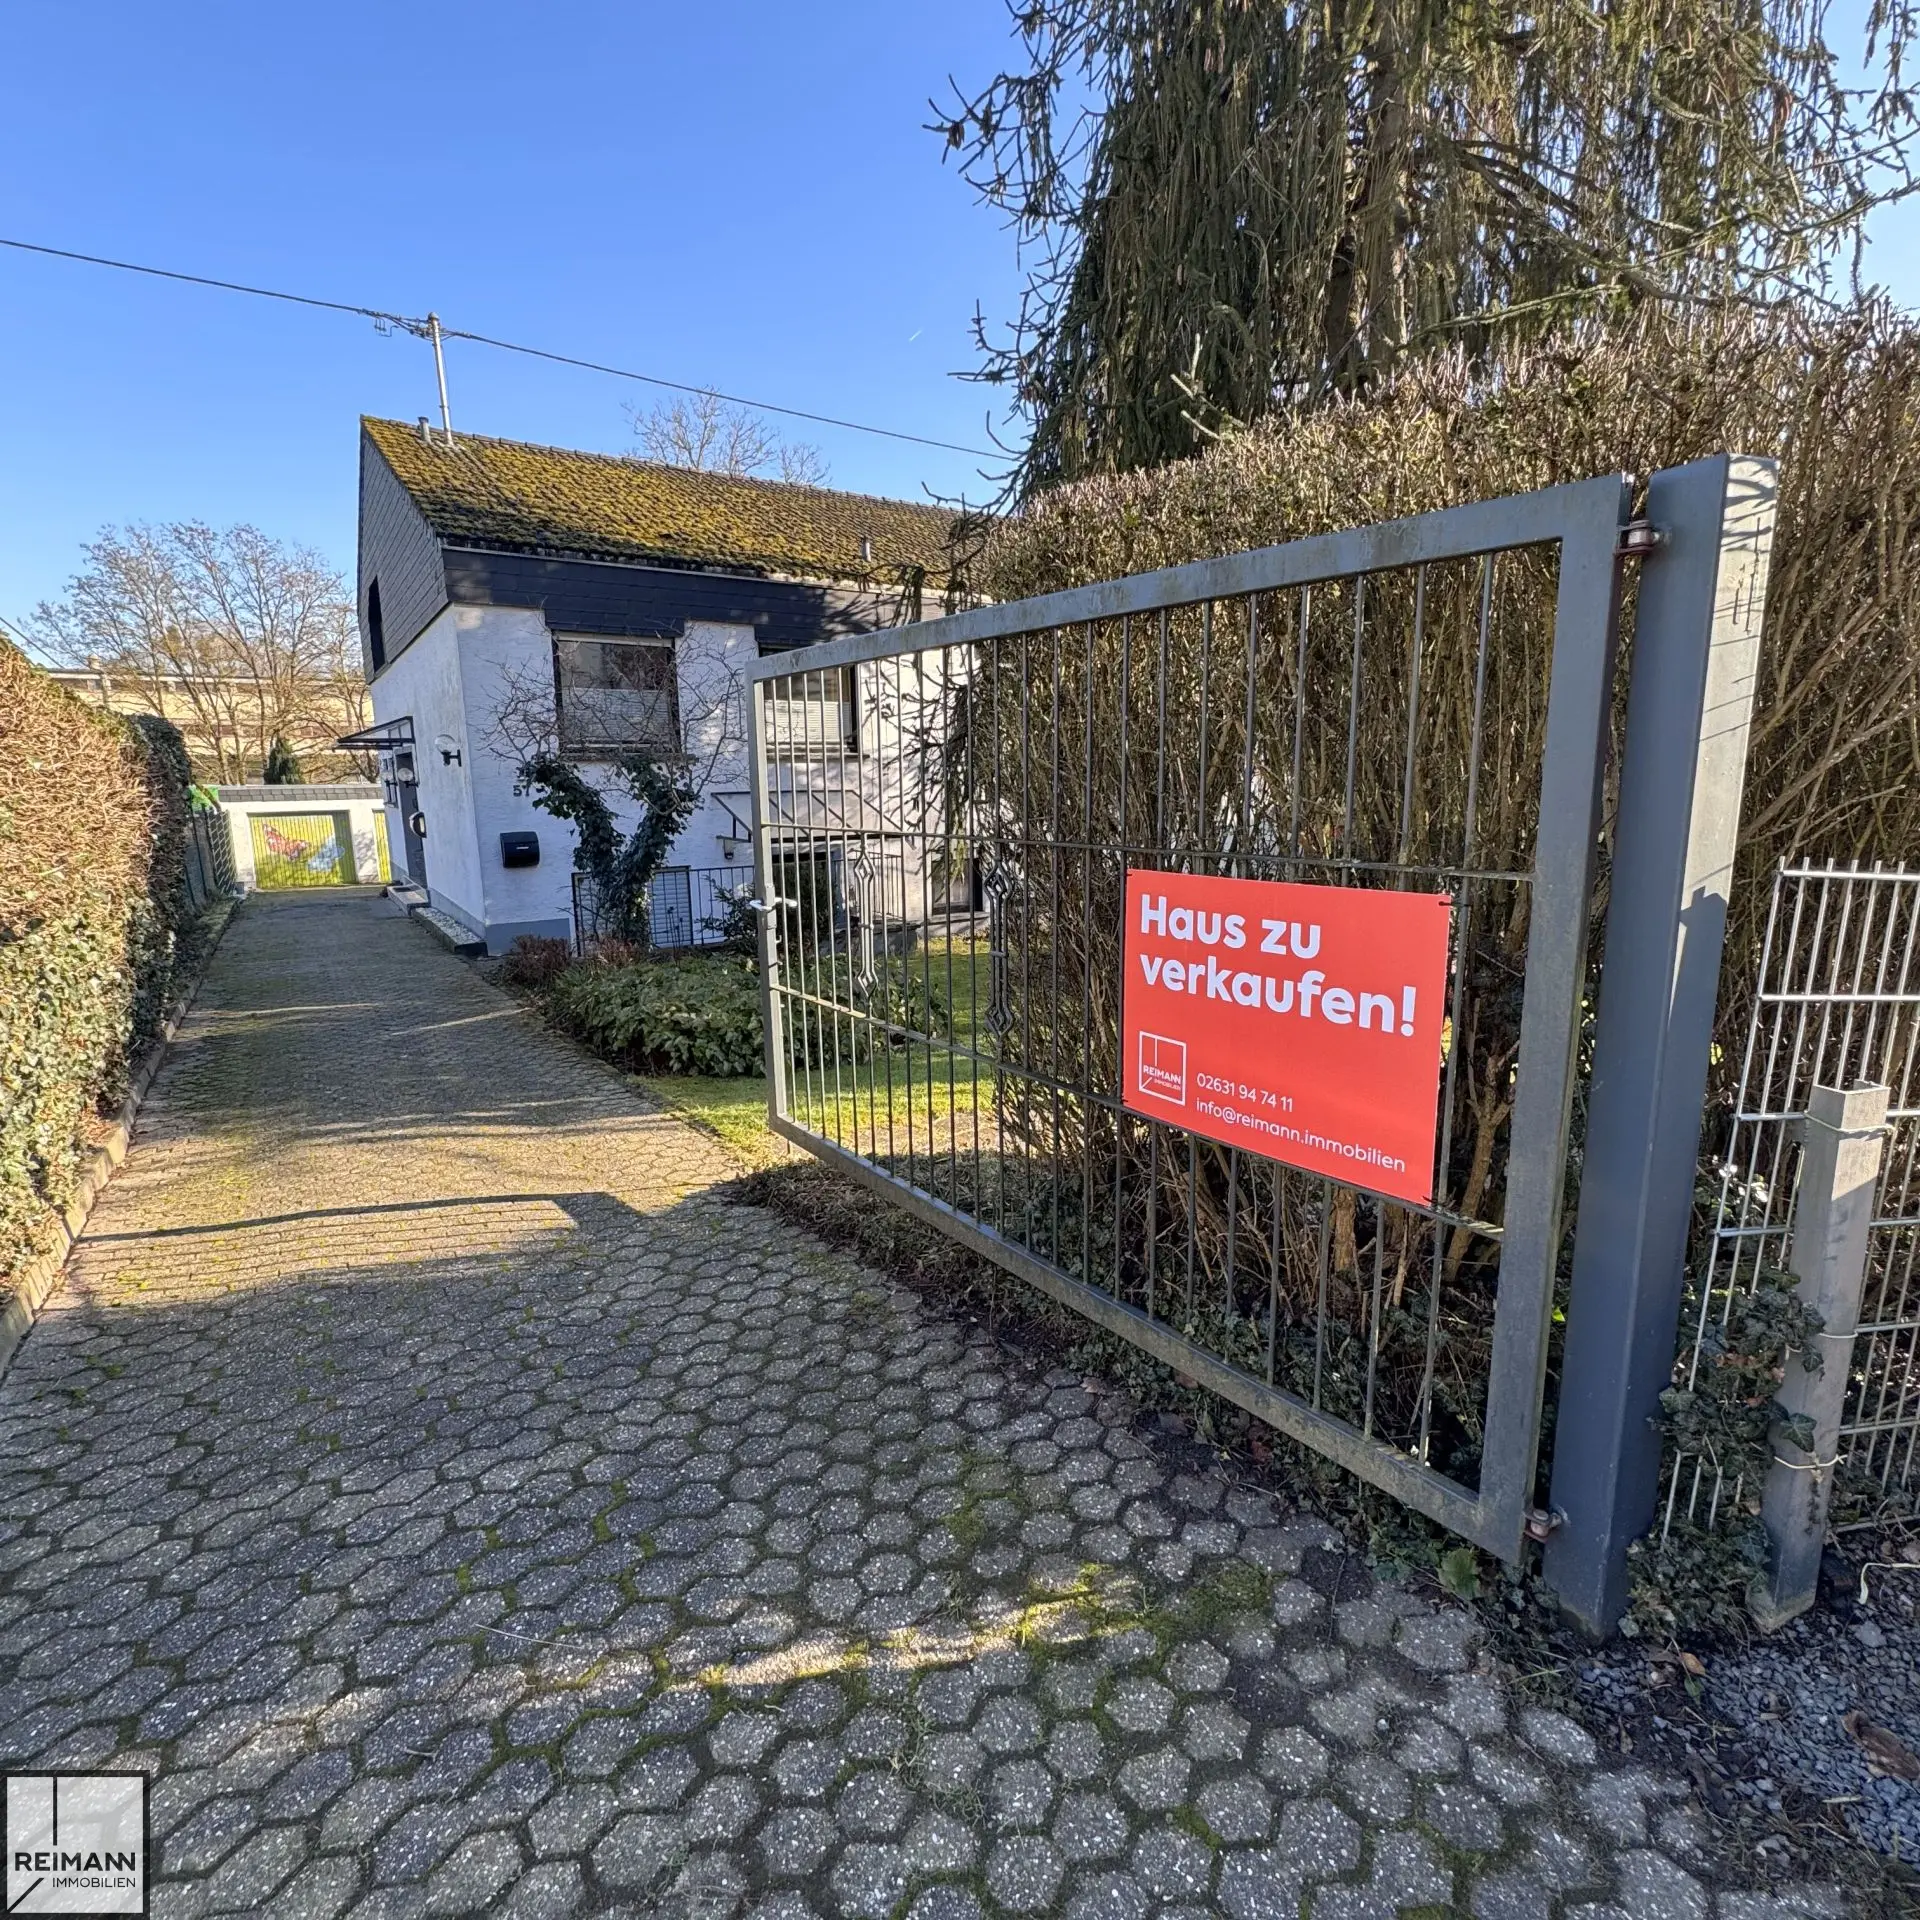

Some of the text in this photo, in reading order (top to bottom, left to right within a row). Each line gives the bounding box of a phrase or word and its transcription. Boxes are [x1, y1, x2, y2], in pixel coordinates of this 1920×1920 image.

[1140, 894, 1322, 960] Haus zu
[1139, 954, 1418, 1038] verkaufen!
[1143, 1064, 1182, 1085] REIMANN
[1197, 1072, 1294, 1113] 02631 94 74 11
[1196, 1097, 1406, 1174] info@reimann.immobilien
